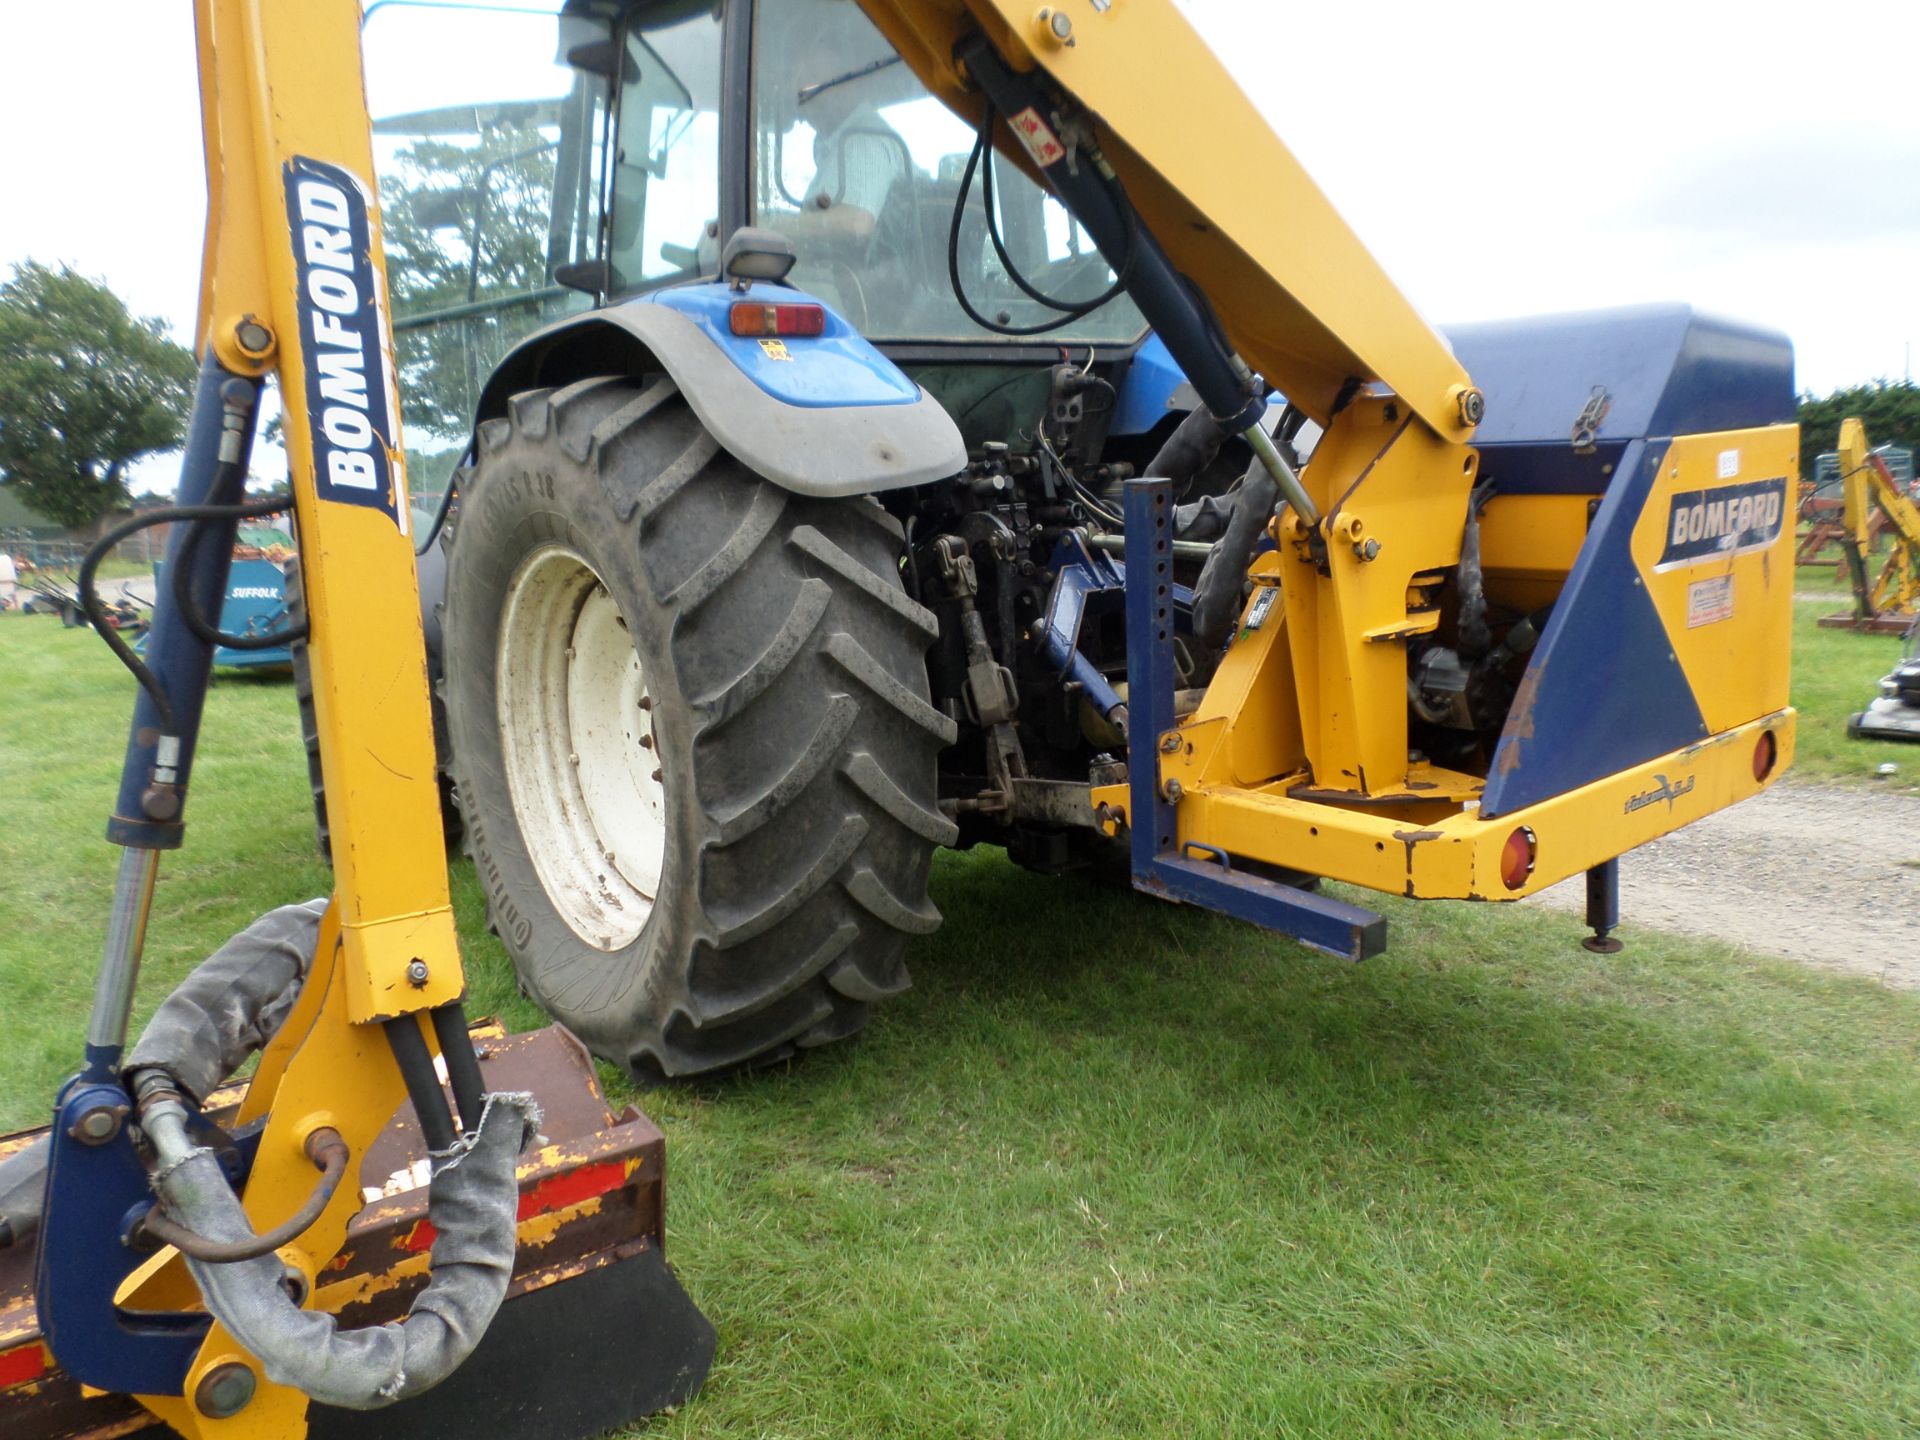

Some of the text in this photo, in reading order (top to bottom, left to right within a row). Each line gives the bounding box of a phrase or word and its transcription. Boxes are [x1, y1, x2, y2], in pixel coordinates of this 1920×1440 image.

[297, 180, 377, 490] BOMFORD
[1672, 491, 1780, 546] BOMFORD
[231, 586, 280, 599] SUFFOLK
